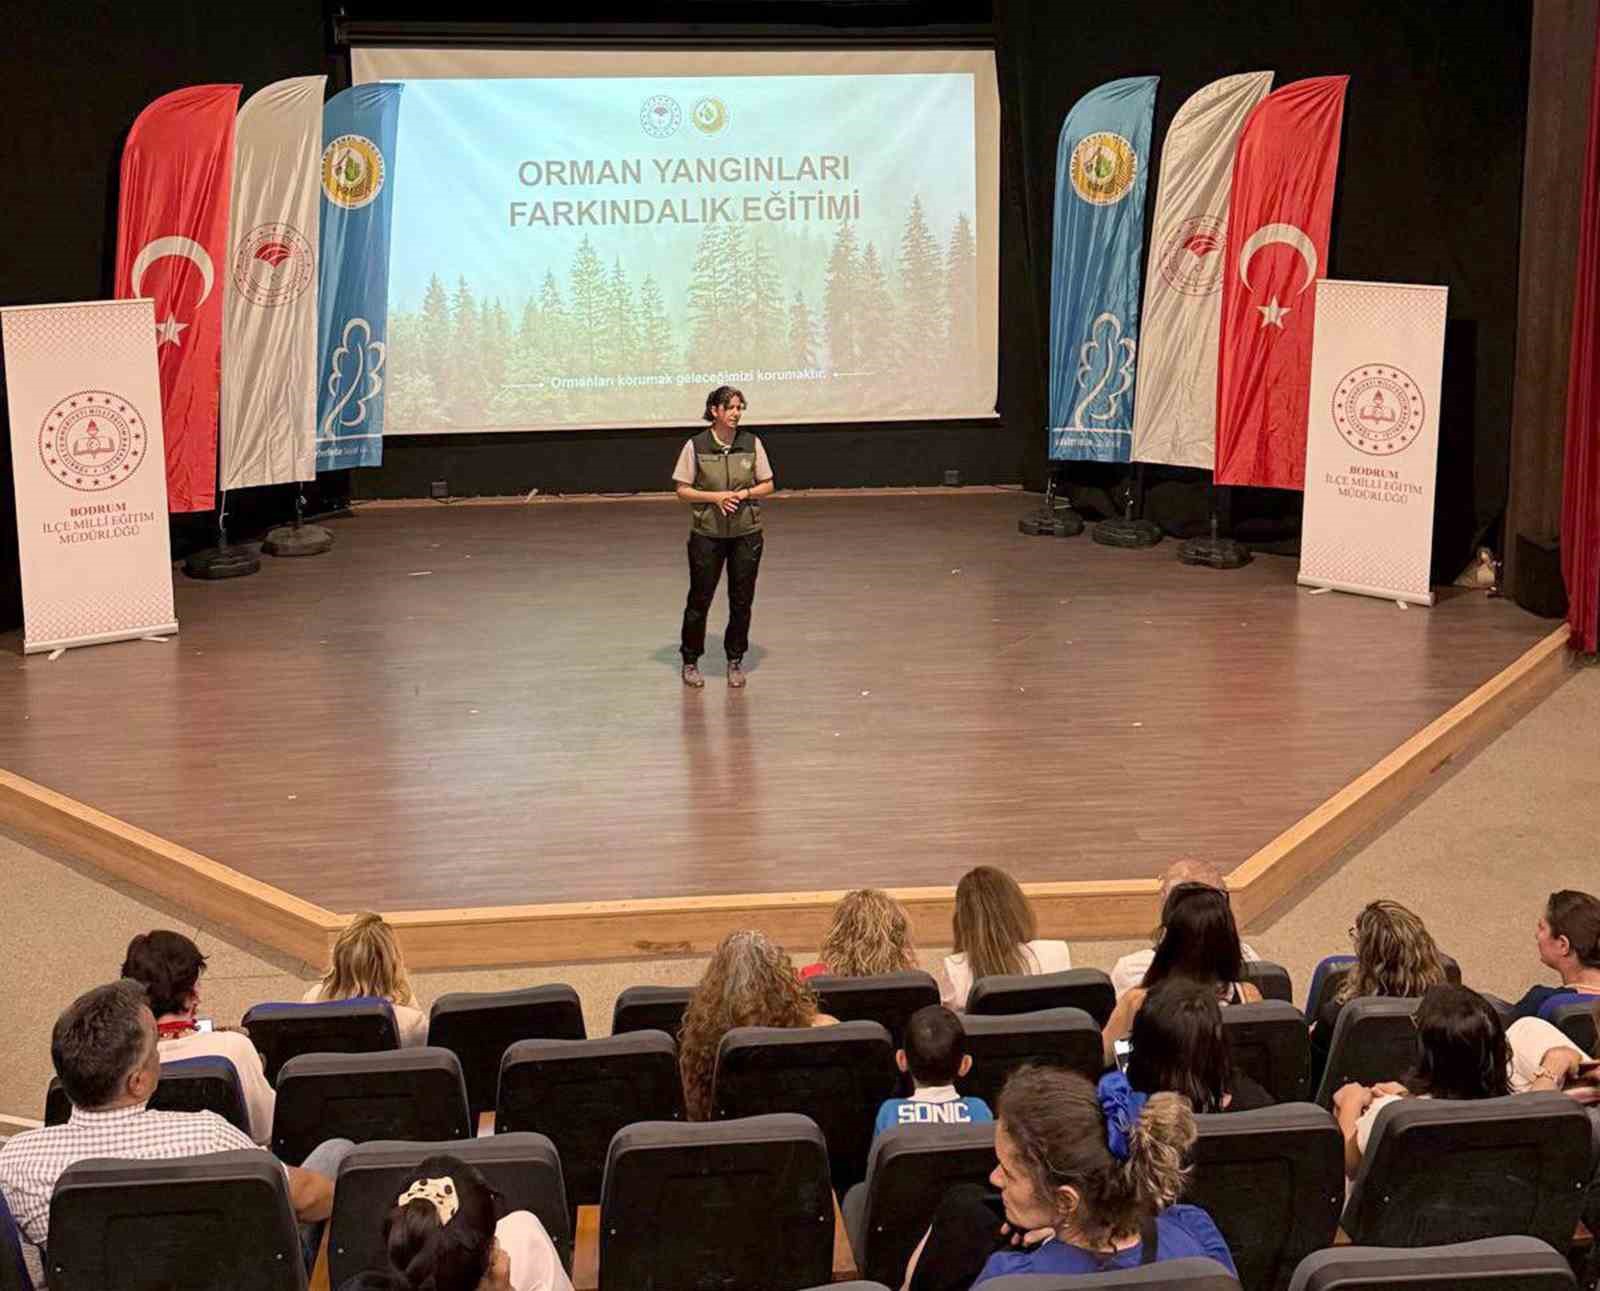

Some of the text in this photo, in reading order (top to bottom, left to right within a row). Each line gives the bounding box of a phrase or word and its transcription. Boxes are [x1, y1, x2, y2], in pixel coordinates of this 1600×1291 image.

[518, 155, 849, 186] ORMAN YANGINLARI
[510, 189, 860, 227] FARKINDALIK EĞİTİMİ
[1349, 466, 1399, 479] BODRUM
[69, 502, 126, 517] BODRUM
[42, 520, 71, 534] İLÇE
[111, 511, 155, 526] EĞİTİM
[59, 525, 140, 544] MÜDÜRLÜĞÜ
[898, 1102, 972, 1124] SONIC
